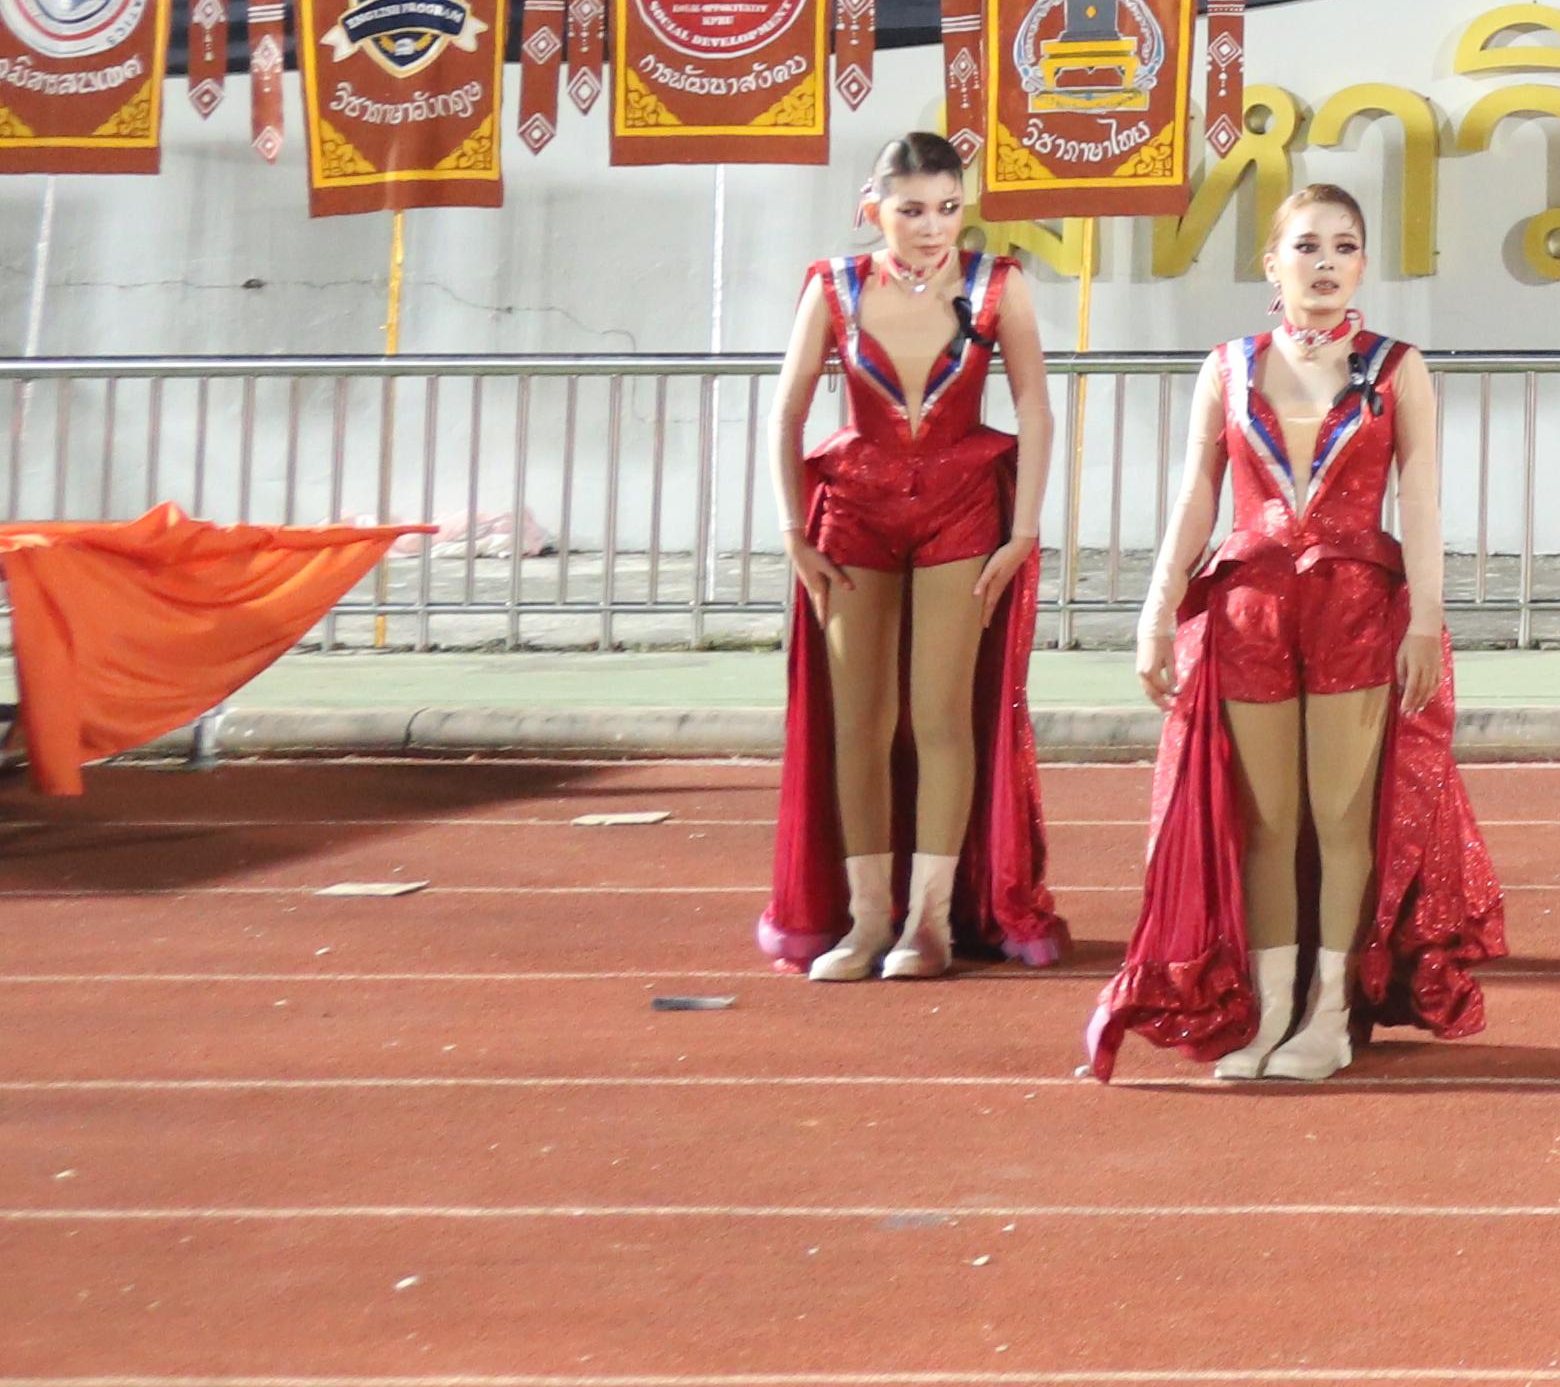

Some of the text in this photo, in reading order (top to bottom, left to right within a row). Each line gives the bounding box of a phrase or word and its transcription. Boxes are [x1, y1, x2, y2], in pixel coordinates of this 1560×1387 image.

[401, 2, 465, 25] PROGRAM
[649, 0, 792, 48] SOCIAL DEVELOPMENT
[1022, 118, 1151, 163] วิชาภาษาไทย
